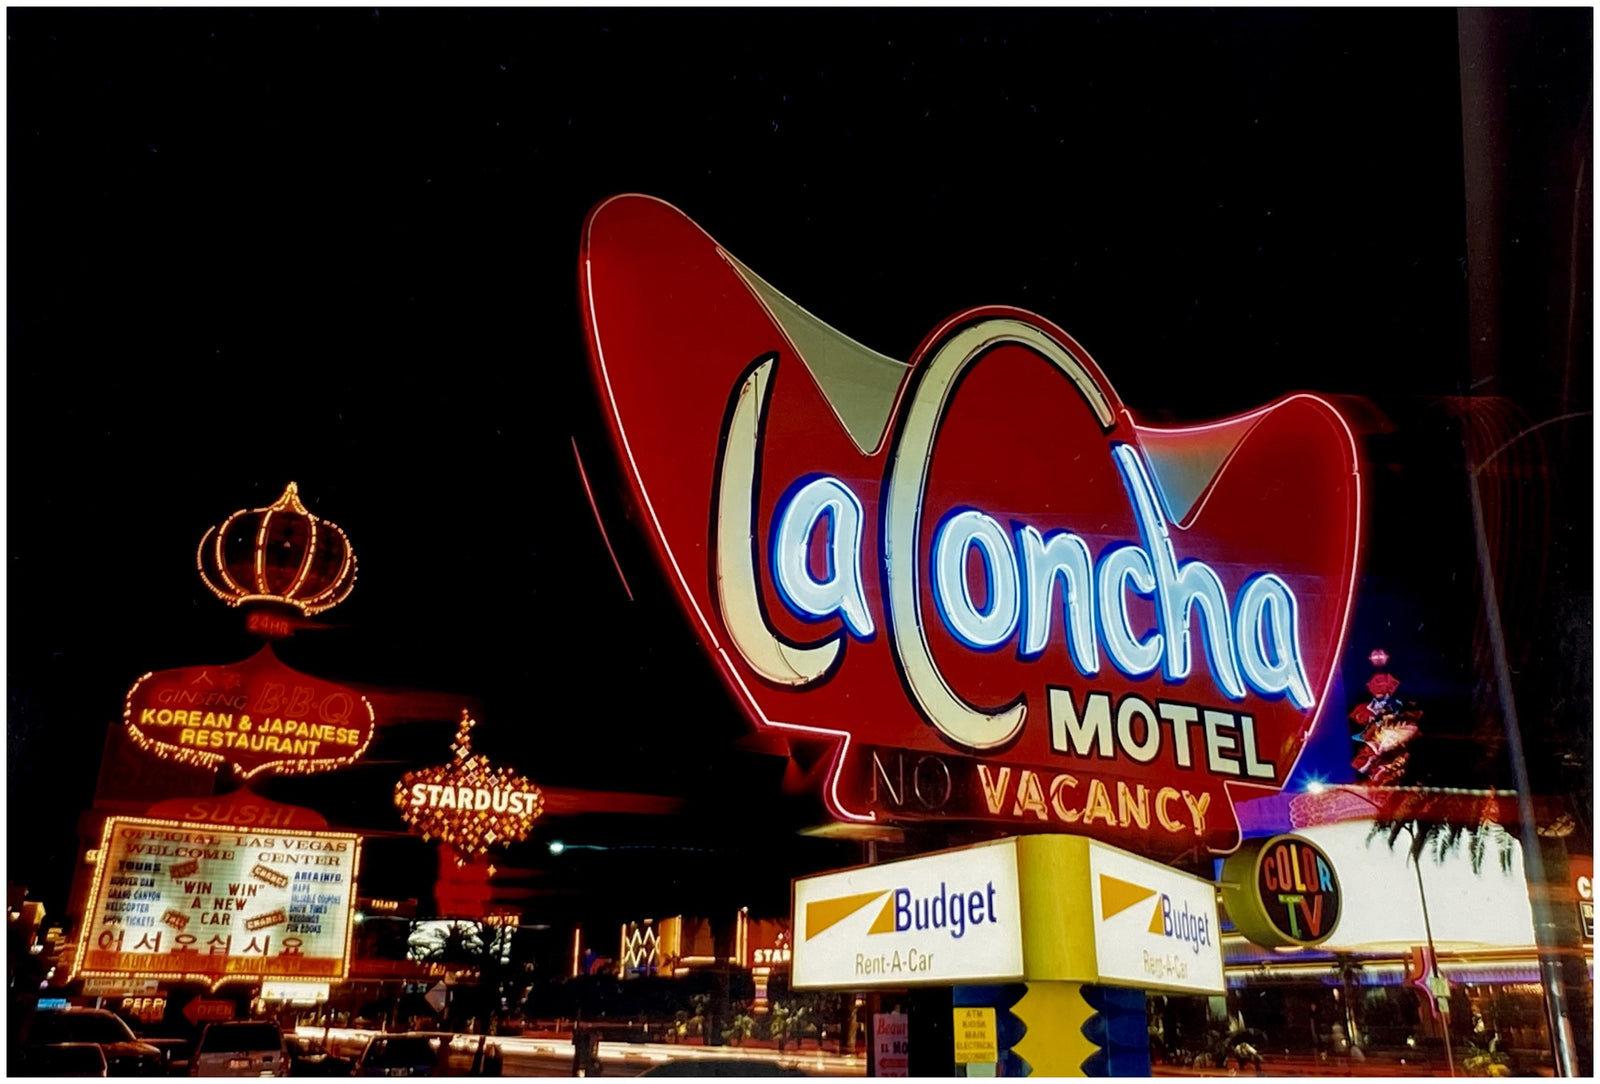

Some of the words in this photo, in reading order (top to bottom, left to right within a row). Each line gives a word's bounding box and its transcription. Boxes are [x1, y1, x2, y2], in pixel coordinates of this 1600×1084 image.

[714, 353, 876, 689] La
[882, 317, 1316, 749] Concha
[158, 688, 249, 711] GINSENG
[141, 709, 232, 728] KOREAN
[238, 715, 252, 731] &
[257, 718, 361, 746] JAPANESE
[1049, 687, 1277, 779] MOTEL
[180, 729, 321, 755] RESTAURANT
[410, 783, 539, 814] STARDUST
[871, 750, 953, 808] NO
[976, 764, 1212, 836] VACANCY
[185, 802, 296, 826] SUSHI
[121, 829, 220, 846] OFFICIAL
[235, 837, 278, 849] LAS
[283, 839, 348, 852] VEGAS
[118, 861, 162, 873] TOURS
[126, 844, 235, 861] WELCOME
[258, 853, 341, 867] CENTER
[1264, 844, 1334, 892] COLOR
[191, 896, 202, 909] A
[213, 897, 248, 911] NEW
[894, 881, 997, 939] Budget
[1278, 894, 1323, 938] TV
[200, 911, 231, 926] CAR
[1161, 894, 1211, 954] Budget
[855, 948, 934, 976] Rent-A-Car
[197, 1005, 232, 1017] OPEN
[966, 1010, 983, 1018] ATM
[956, 1041, 995, 1050] ELECTRICAL
[965, 1031, 986, 1039] MAIN
